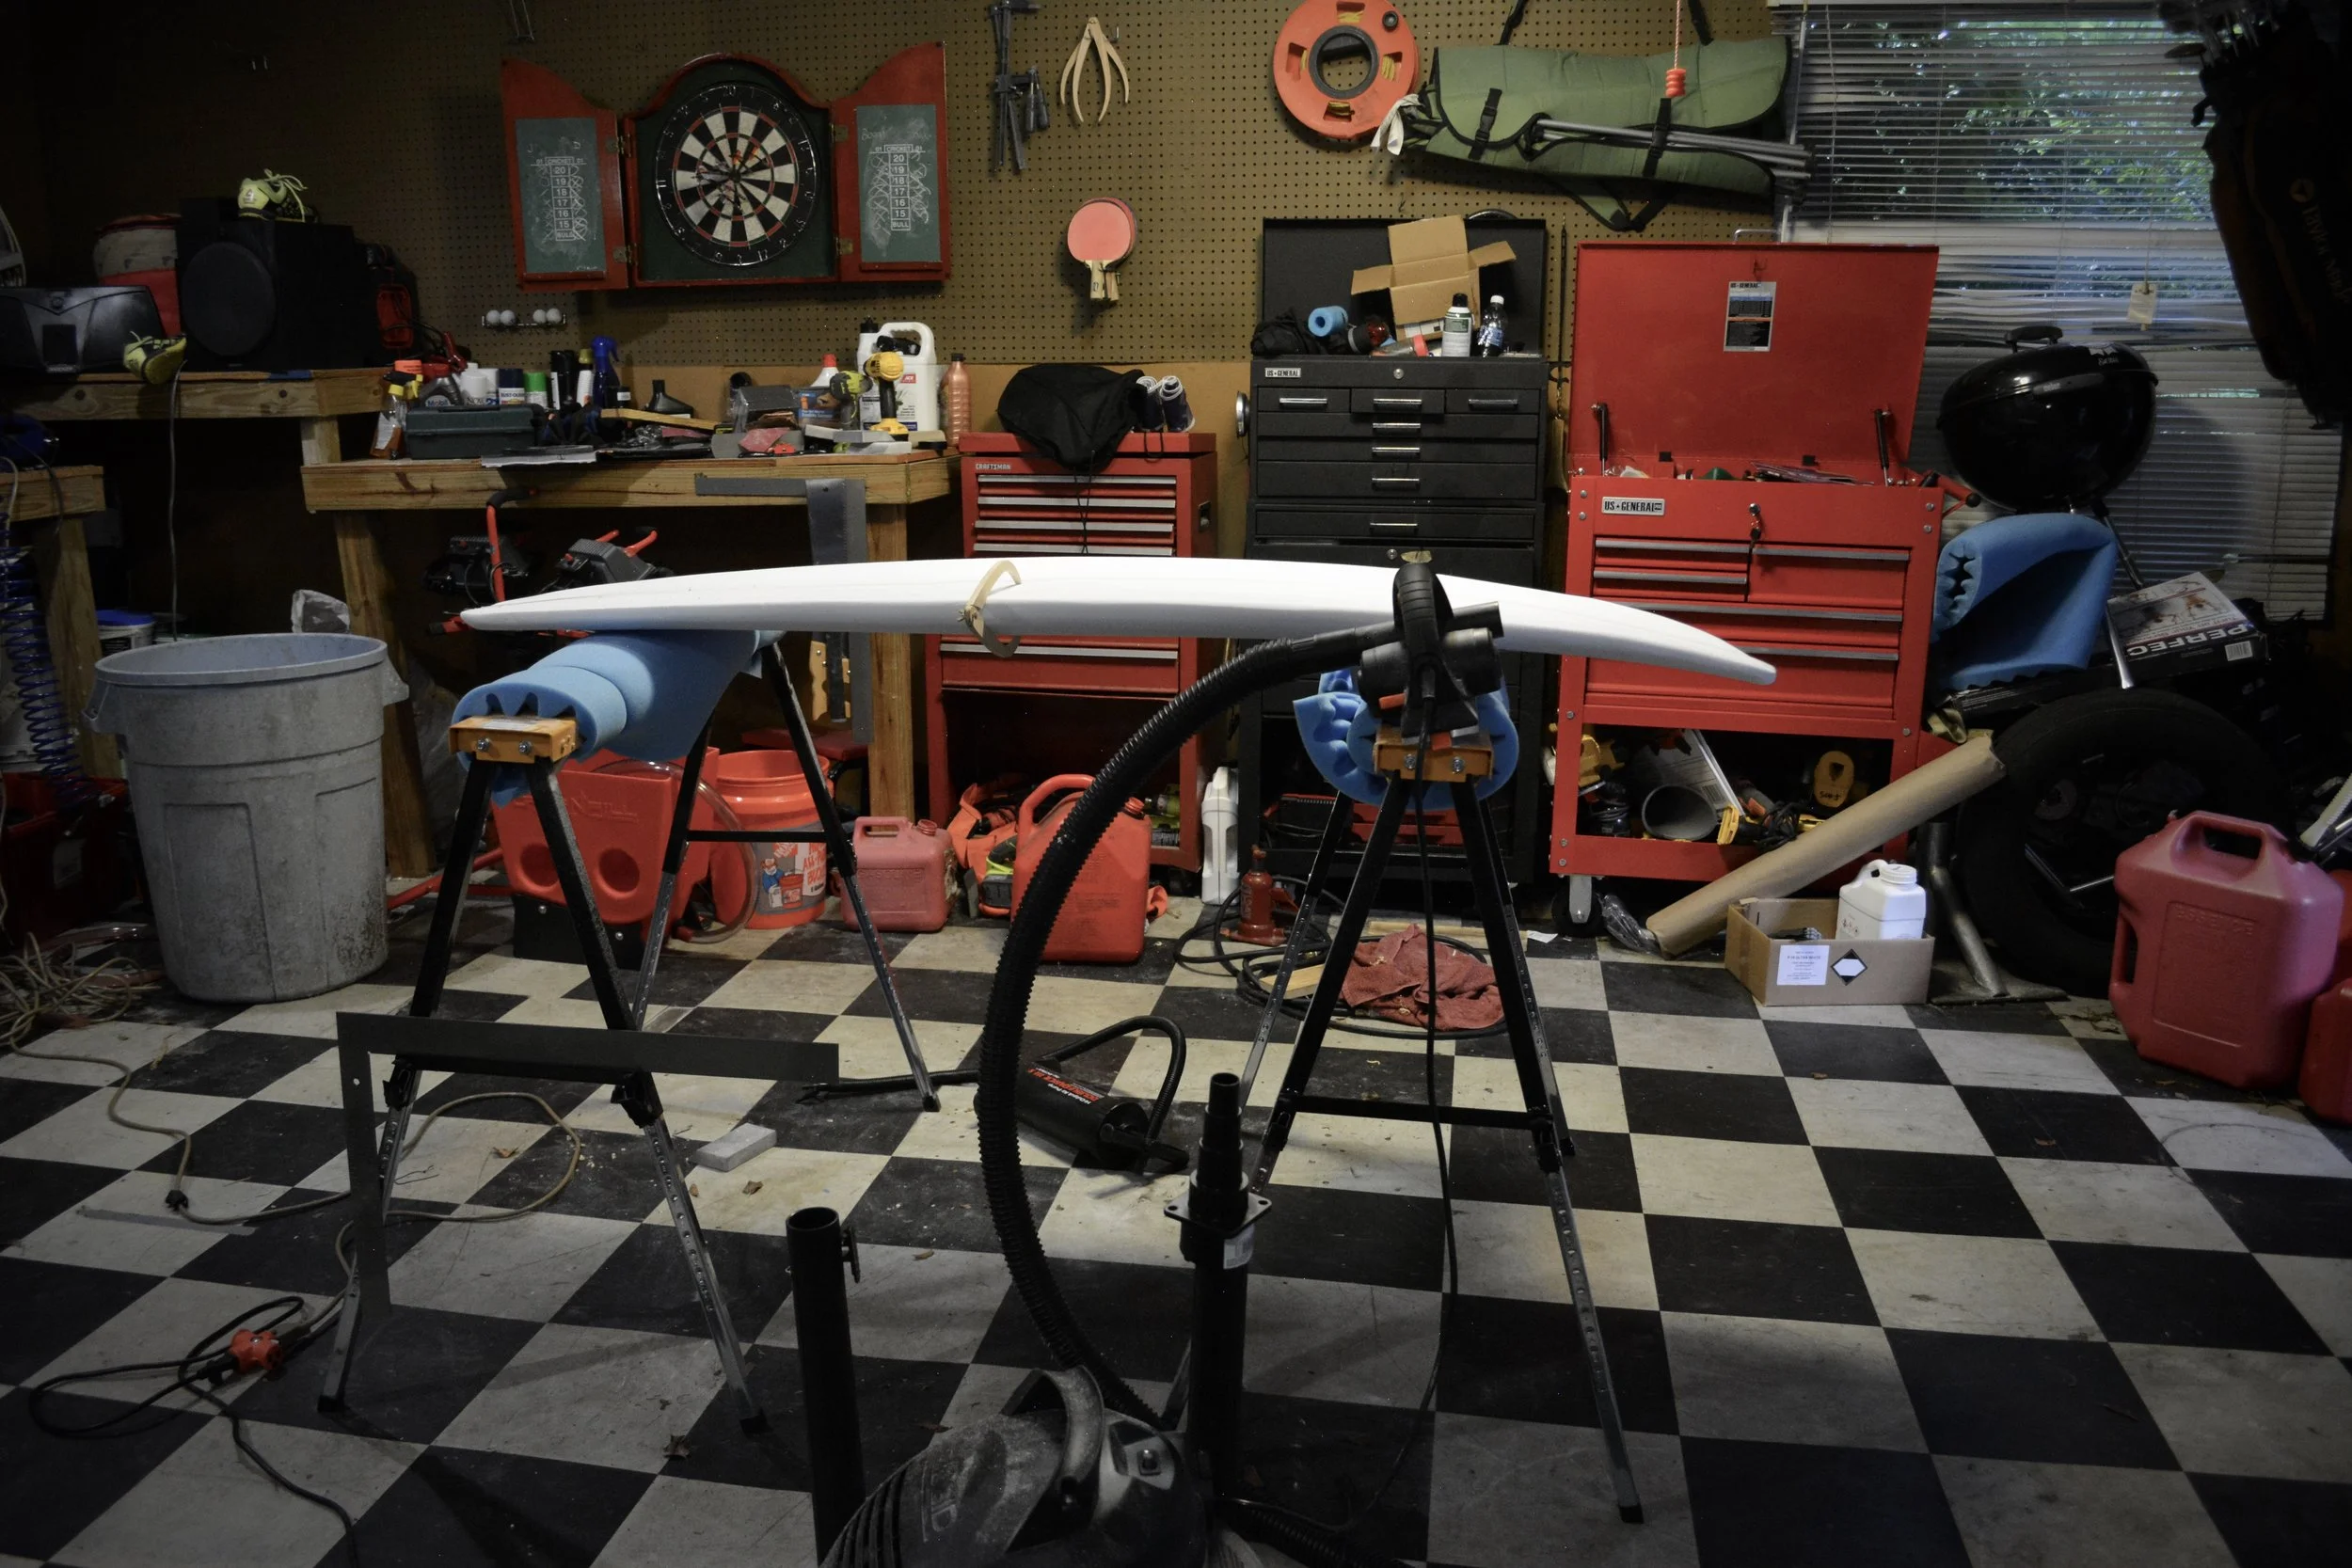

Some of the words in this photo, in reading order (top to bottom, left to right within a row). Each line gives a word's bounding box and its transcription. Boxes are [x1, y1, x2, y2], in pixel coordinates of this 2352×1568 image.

[894, 154, 904, 163] 20
[557, 198, 568, 207] 17
[896, 210, 906, 218] 15
[559, 220, 570, 229] 15
[1604, 500, 1615, 511] US
[1621, 501, 1655, 512] GENERAL
[2126, 624, 2249, 657] PERFEC
